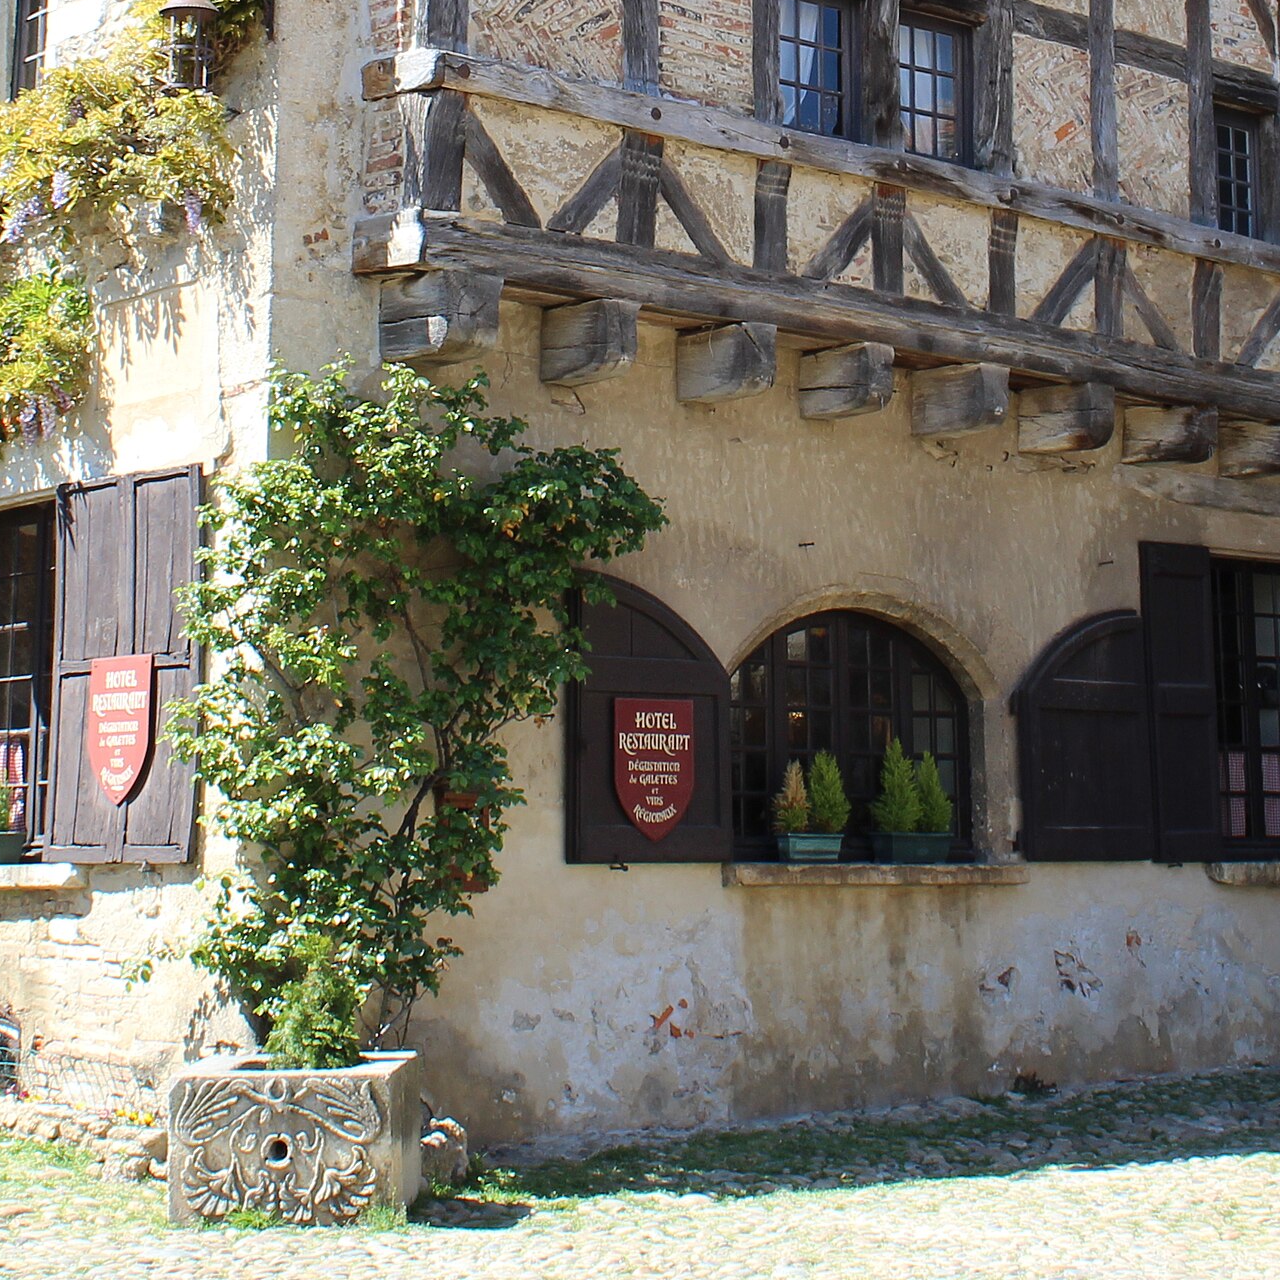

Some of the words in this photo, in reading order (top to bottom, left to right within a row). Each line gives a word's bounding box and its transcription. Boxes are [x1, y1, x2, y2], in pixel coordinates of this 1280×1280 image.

[106, 670, 137, 688] HOTEL
[92, 690, 148, 717] RESTAURANT
[635, 712, 677, 730] HOTEL
[619, 732, 690, 757] RESTAURANT
[628, 759, 681, 772] DÉGUSTATION
[629, 774, 638, 784] de
[639, 773, 678, 787] GALETTES
[645, 795, 664, 806] VINS
[633, 803, 678, 824] RÉGIONAUX
